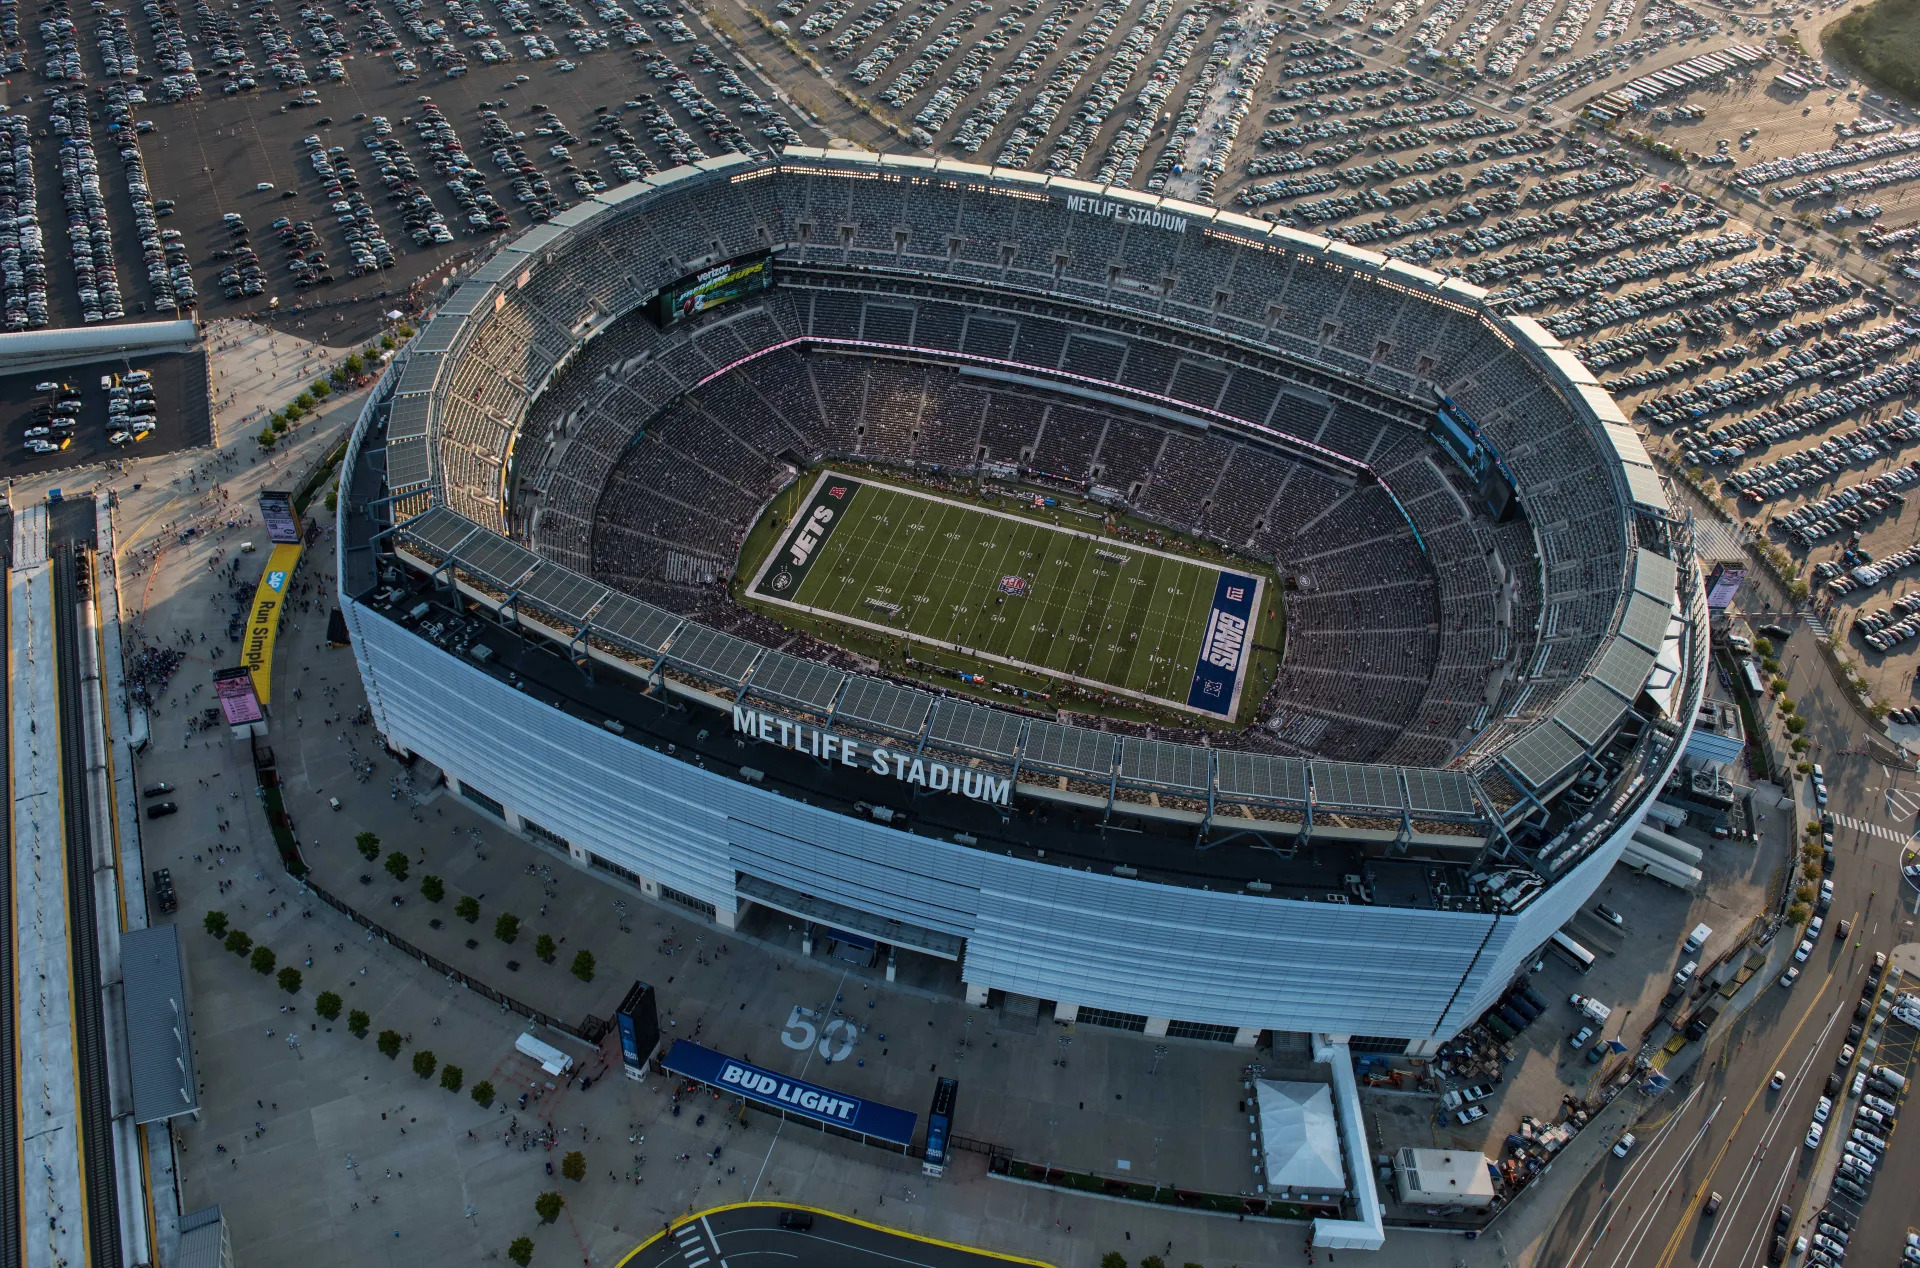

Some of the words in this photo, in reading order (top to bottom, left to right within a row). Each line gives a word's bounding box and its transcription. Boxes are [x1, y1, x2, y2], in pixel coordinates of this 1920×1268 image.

[1066, 195, 1124, 220] METLIFE
[1127, 206, 1188, 233] STADIUM
[697, 263, 731, 282] verizon
[789, 505, 834, 567] JETS
[267, 571, 284, 590] SAP
[259, 601, 276, 624] Run
[245, 627, 270, 672] Simple
[1209, 611, 1246, 672] GIANTS
[732, 705, 859, 768] METLIFE
[871, 748, 1012, 805] STADIUM
[780, 1004, 858, 1062] 50
[720, 1064, 778, 1096] BUD
[776, 1082, 855, 1120] LIGHT
